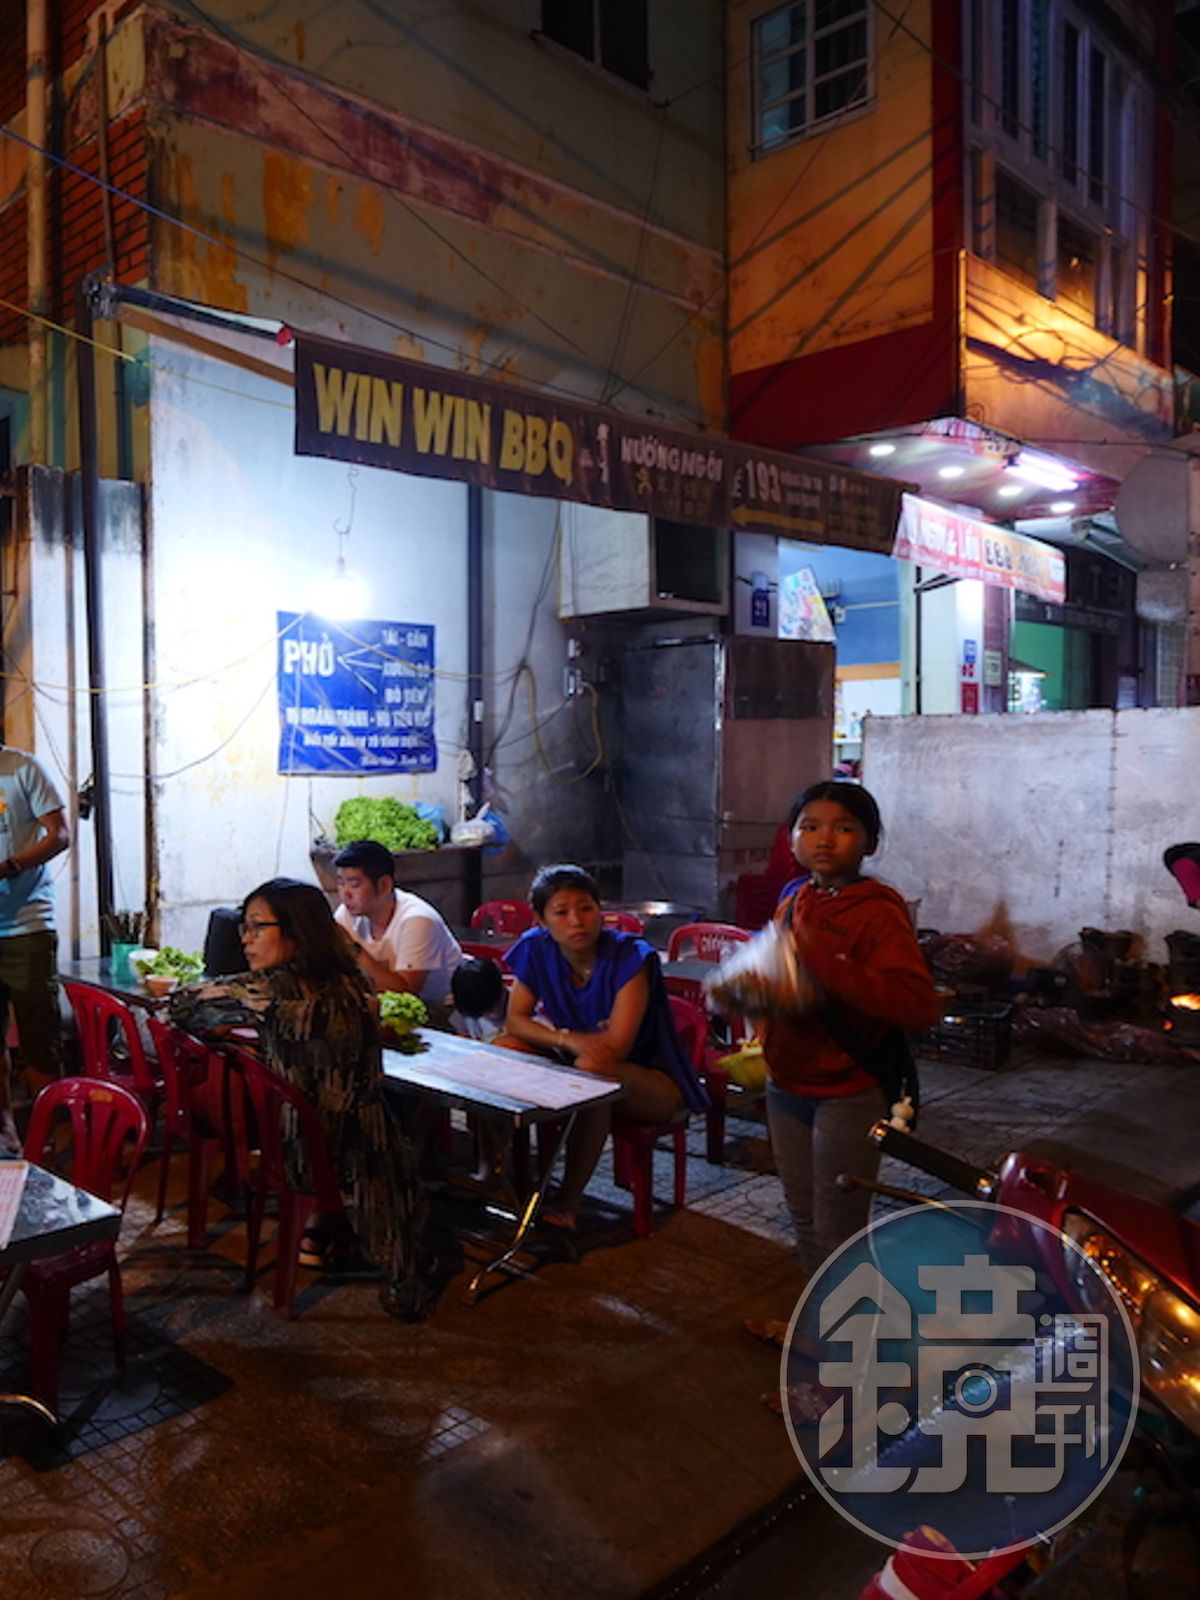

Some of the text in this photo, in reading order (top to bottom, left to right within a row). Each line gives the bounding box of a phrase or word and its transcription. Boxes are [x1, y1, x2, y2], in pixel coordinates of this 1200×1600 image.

[313, 362, 574, 487] WIN WIN BBQ
[745, 459, 782, 502] 193
[283, 632, 335, 677] PHỞ
